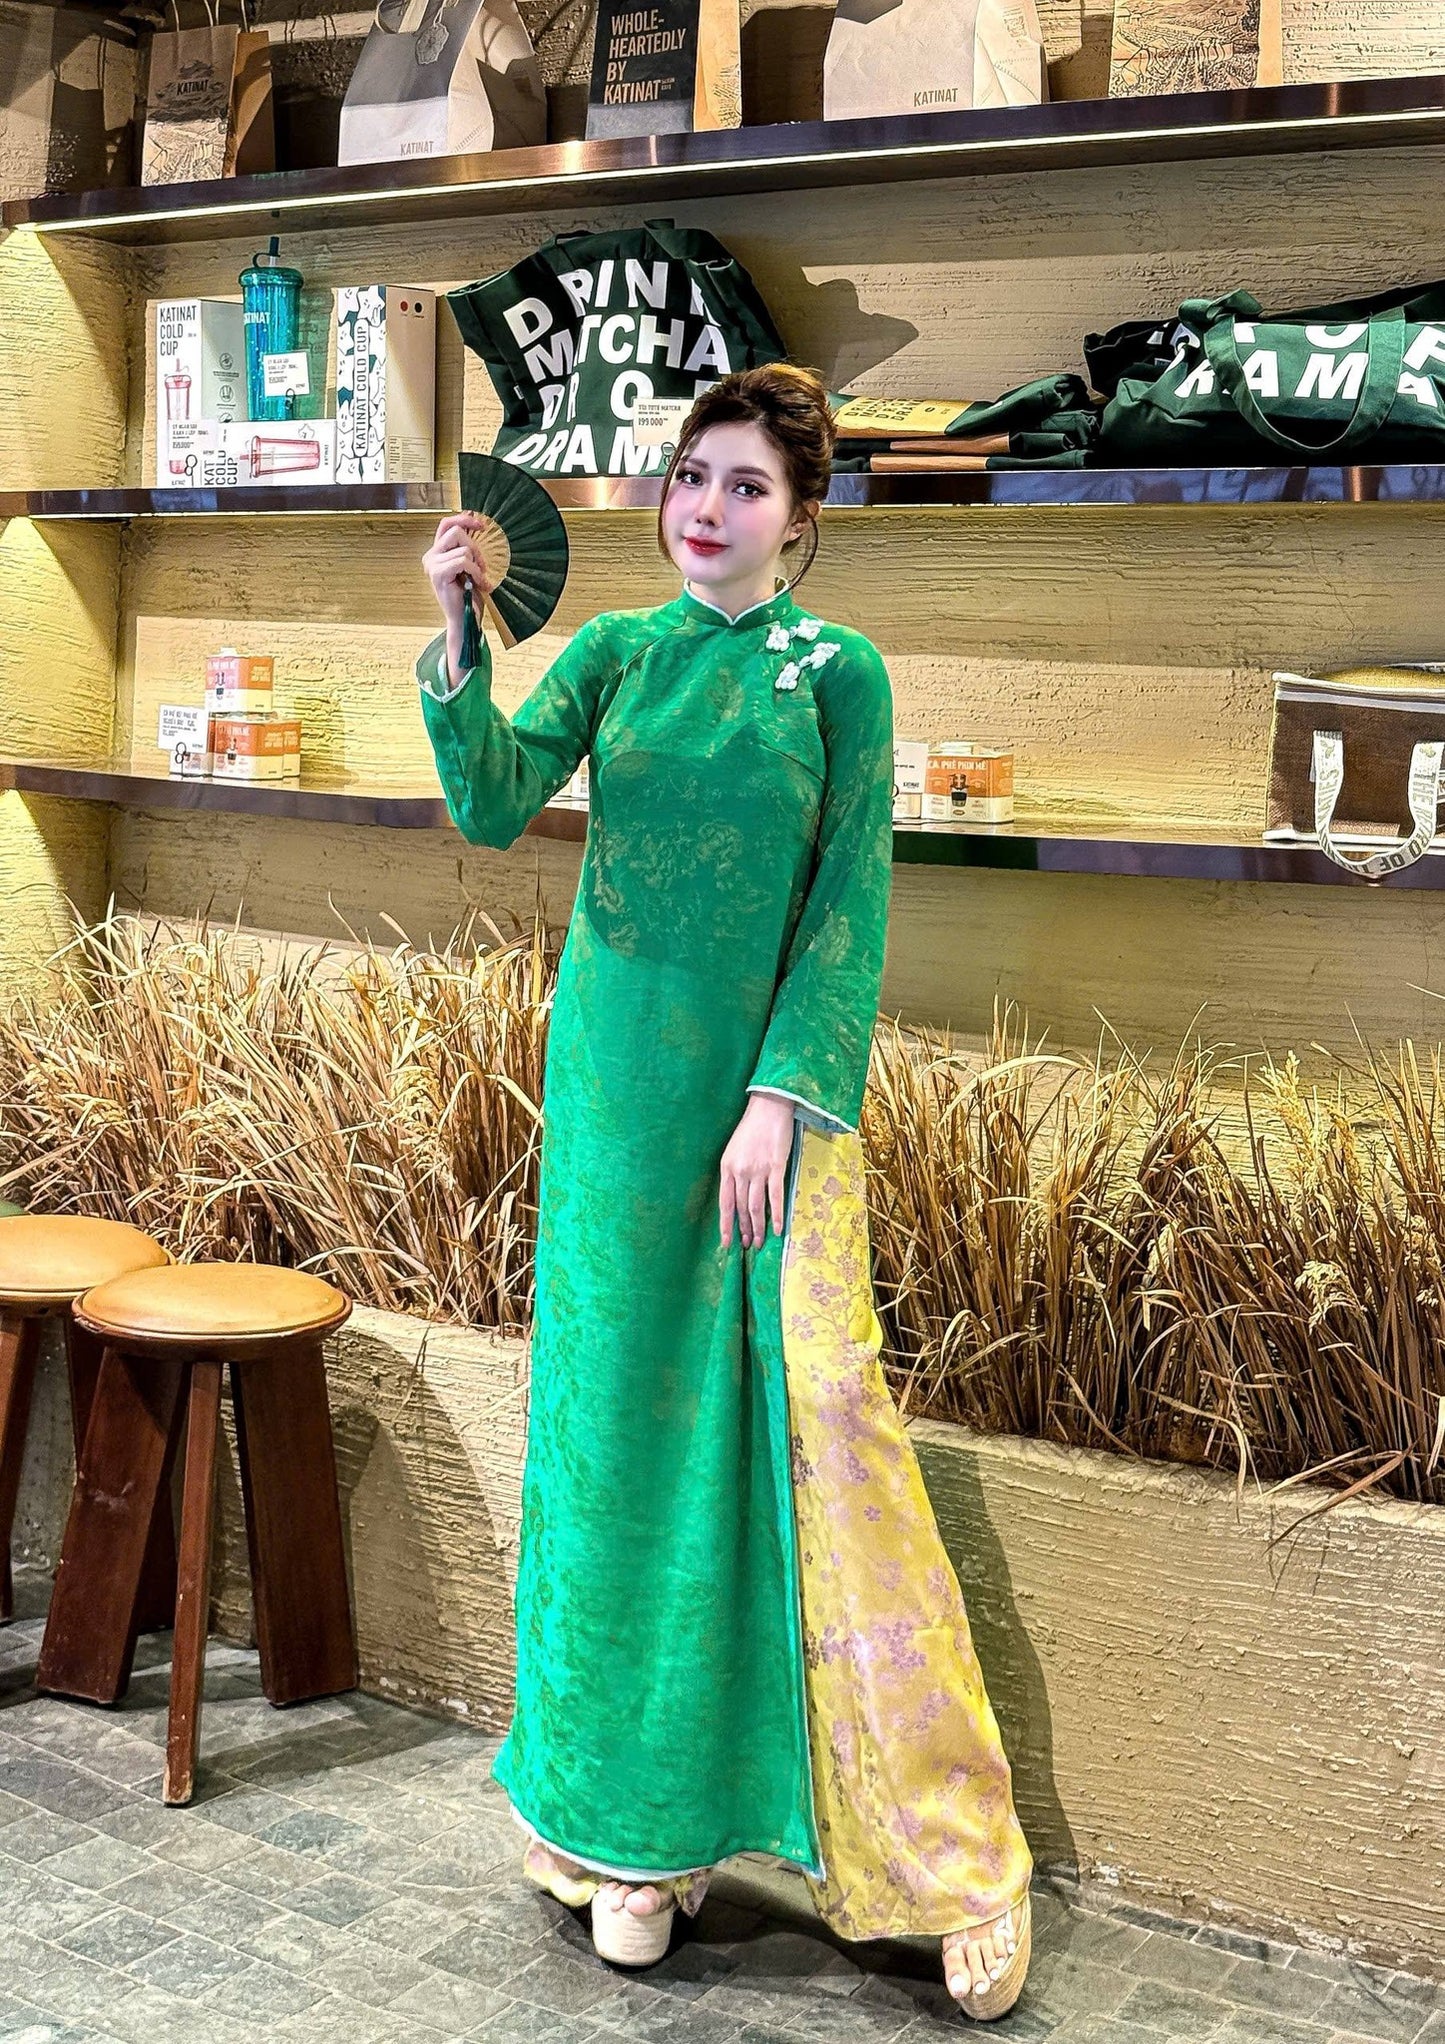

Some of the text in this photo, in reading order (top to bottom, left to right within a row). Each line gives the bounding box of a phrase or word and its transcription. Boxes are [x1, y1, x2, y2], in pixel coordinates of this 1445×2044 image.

[611, 9, 665, 36] WHOLE-
[609, 28, 687, 59] HEARTEDLY
[606, 61, 627, 82] BY
[176, 79, 209, 96] KATINAT
[603, 79, 661, 106] KATINAT
[914, 88, 959, 107] KATINAT
[400, 141, 434, 156] KATINAT
[160, 305, 197, 322] KATINAT
[160, 324, 183, 339] COLD
[160, 341, 179, 356] CUP
[524, 313, 732, 383] MTCHA
[356, 326, 367, 449] KATINAT COLD CUP
[227, 458, 238, 485] CUP
[1413, 772, 1436, 805] THE
[1379, 853, 1406, 872] OF
